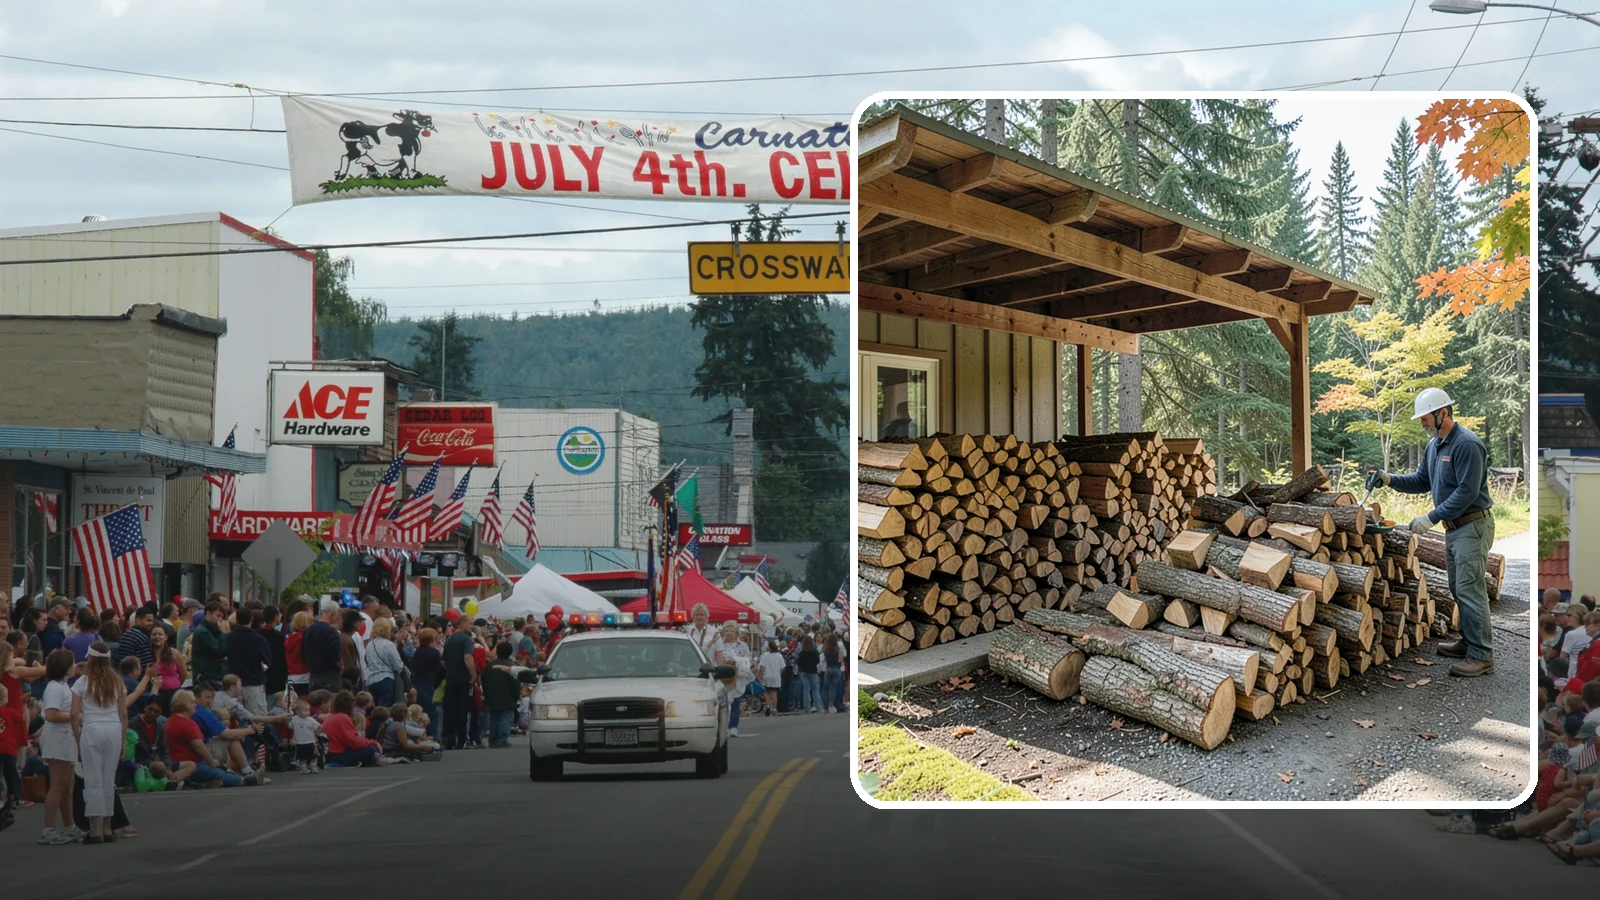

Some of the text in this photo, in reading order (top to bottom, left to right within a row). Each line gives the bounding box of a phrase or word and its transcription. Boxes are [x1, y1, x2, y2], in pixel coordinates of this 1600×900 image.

[481, 141, 605, 193] JULY
[632, 149, 747, 199] 4th.
[696, 254, 850, 280] CROSSWA
[282, 380, 374, 420] ACE
[405, 409, 453, 422] CEDAR
[283, 421, 371, 436] Hardware
[83, 485, 155, 495] St. Vincent de Paul
[687, 526, 742, 535] CRNATION
[698, 535, 731, 543] GLASS
